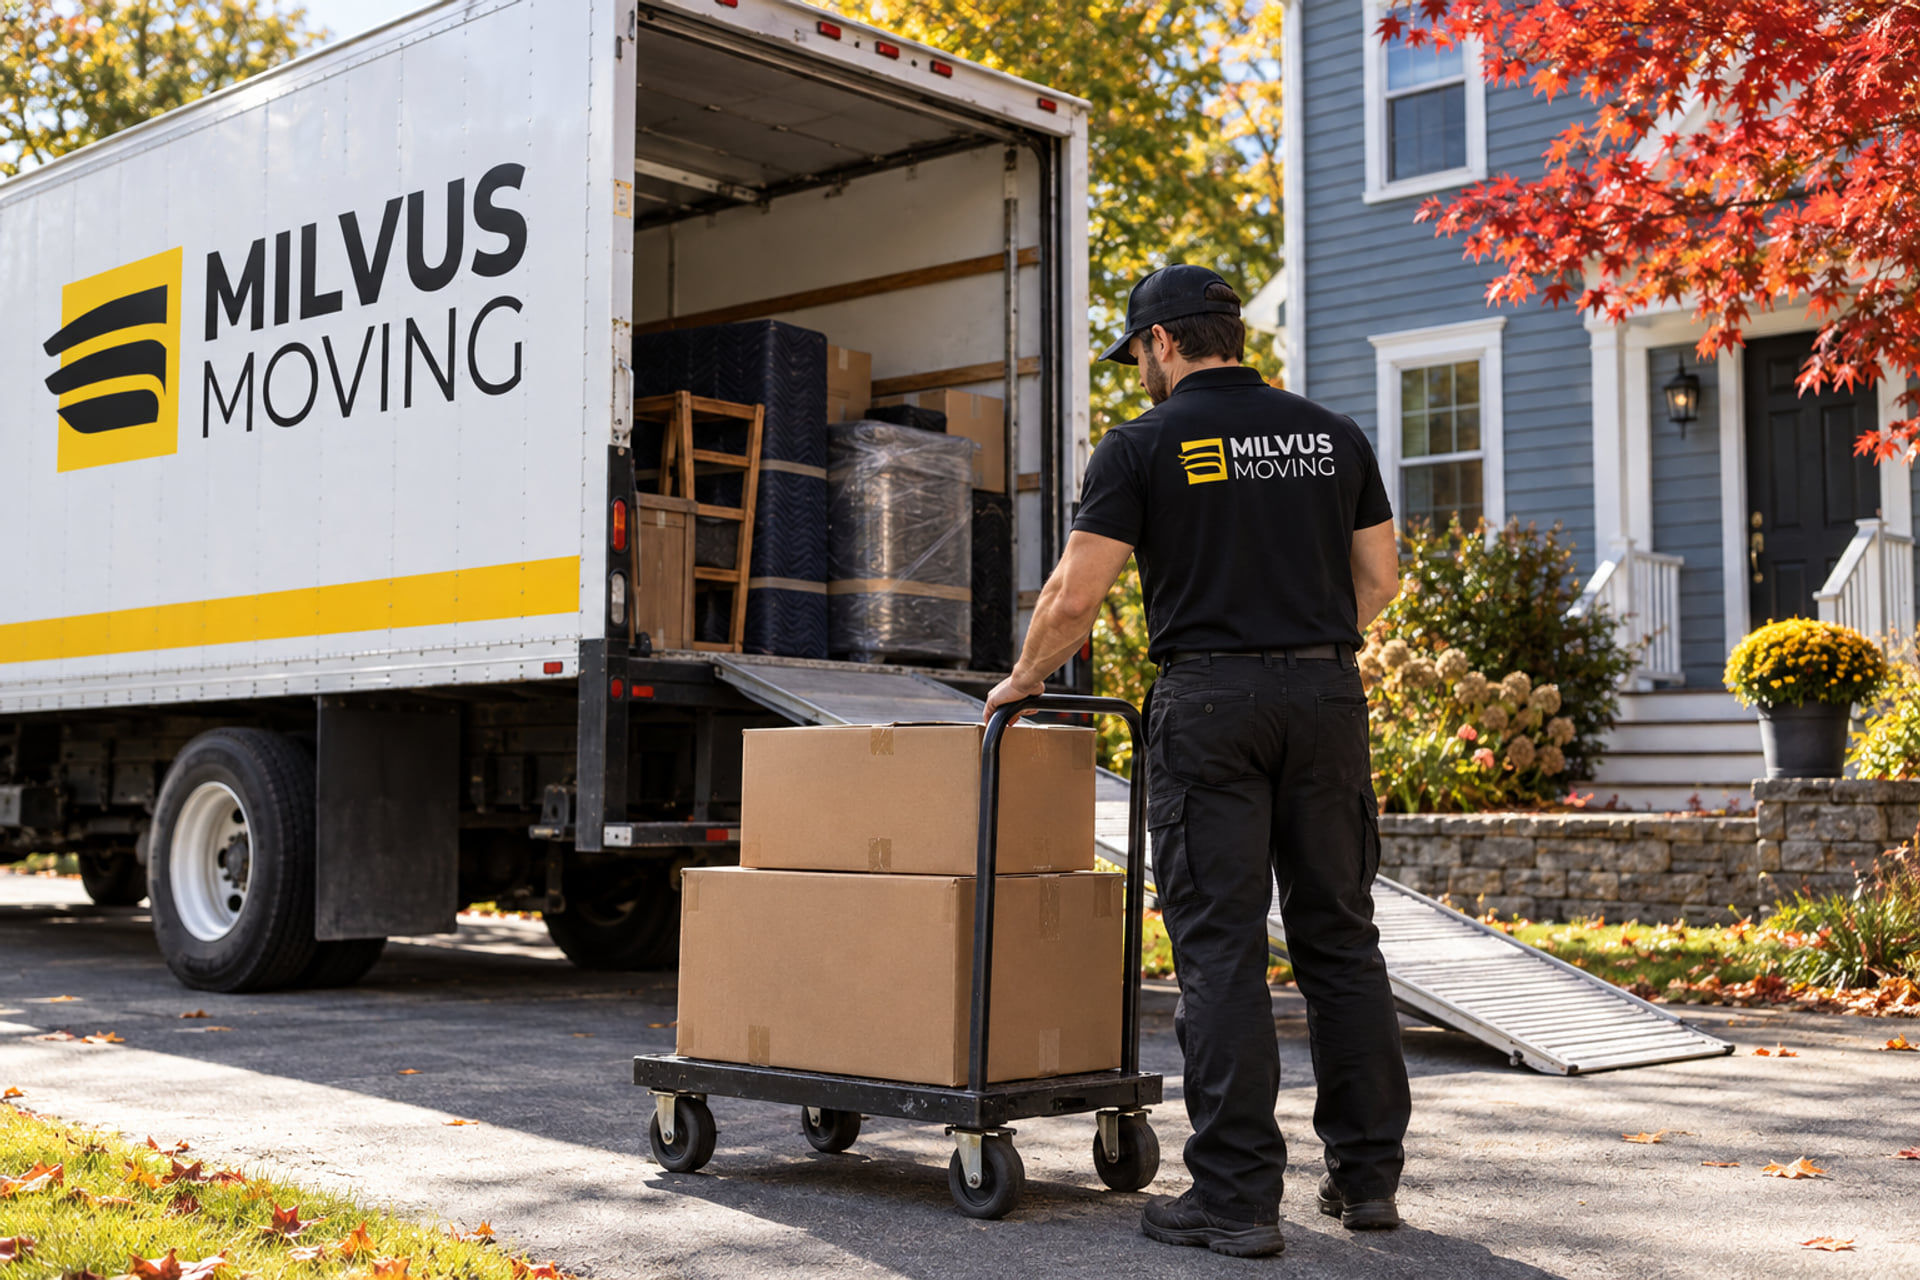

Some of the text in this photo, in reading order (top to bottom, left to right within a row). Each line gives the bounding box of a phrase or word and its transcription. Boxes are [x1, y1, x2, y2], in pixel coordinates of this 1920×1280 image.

[204, 163, 528, 342] MILVUS
[202, 295, 524, 439] MOVING
[1229, 433, 1334, 458] MILVUS
[1233, 456, 1335, 480] MOVING
